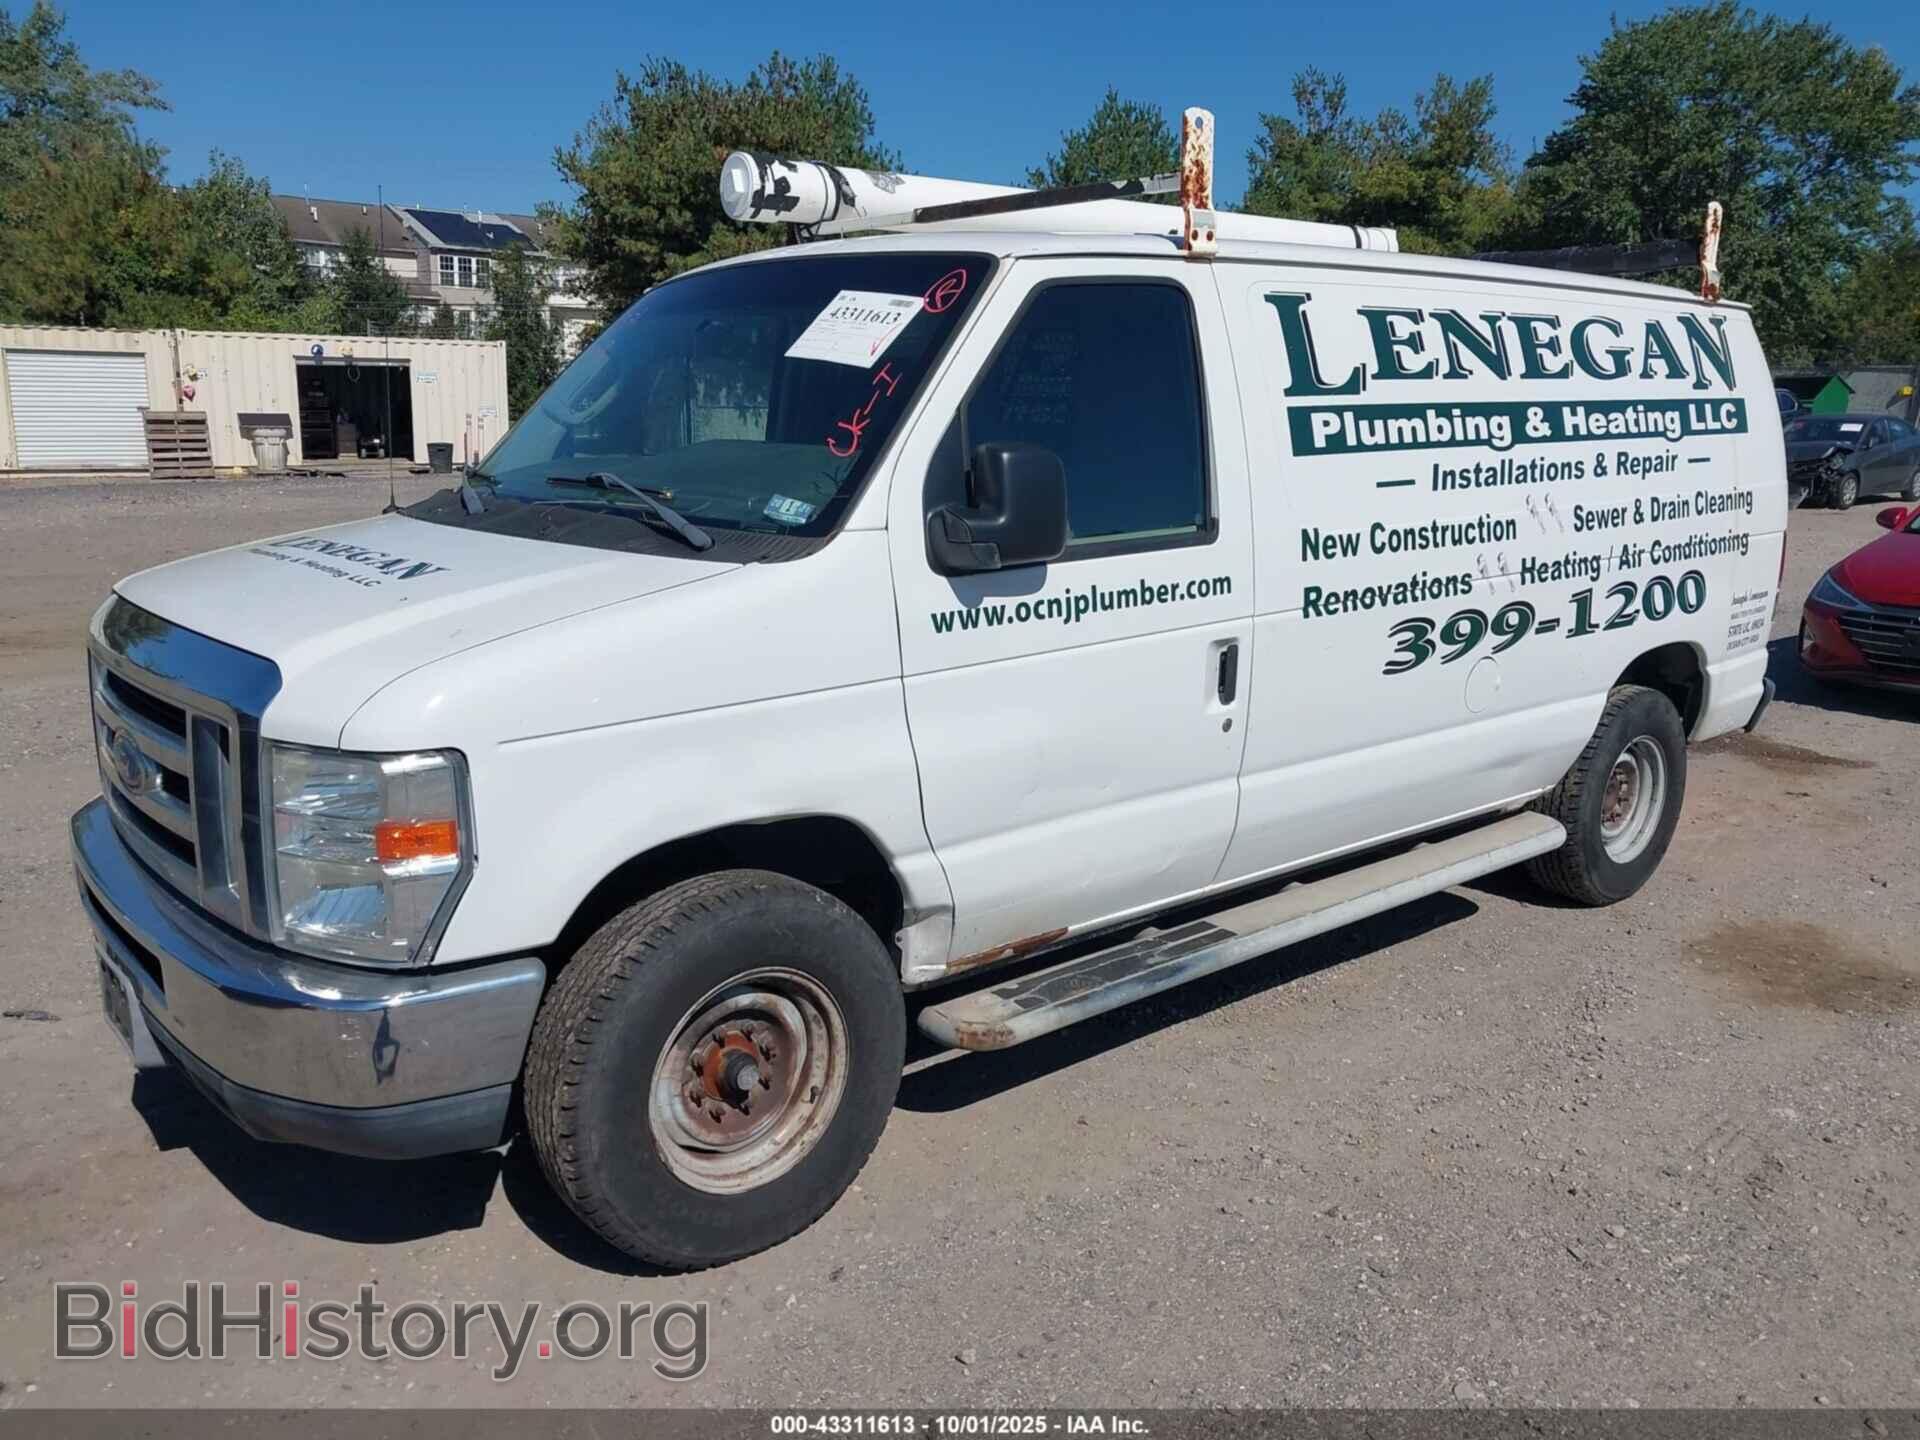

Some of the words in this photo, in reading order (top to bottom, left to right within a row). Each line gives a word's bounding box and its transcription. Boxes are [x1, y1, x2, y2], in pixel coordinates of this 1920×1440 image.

[829, 305, 902, 325] 43311613
[1264, 291, 1737, 397] LENEGAN
[1310, 408, 1512, 448] Plumbing
[1525, 406, 1552, 438] &
[1562, 404, 1682, 440] Heating
[1688, 402, 1738, 431] LLC
[1432, 456, 1585, 492] Installations
[1592, 452, 1608, 478] &
[1616, 449, 1678, 480] Repair
[1573, 504, 1628, 532] Sewer
[1633, 498, 1645, 525] &
[1651, 494, 1690, 523] Drain
[1694, 487, 1753, 516] Cleaning
[267, 536, 451, 580] LENEGAN
[1301, 527, 1361, 563] New
[1369, 513, 1517, 555] Construction
[1520, 550, 1602, 586] Heating
[1618, 543, 1646, 571] Air
[1650, 529, 1750, 566] Conditioning
[348, 574, 382, 588] LLC
[930, 575, 1232, 634] www.ocnjplumber.com
[1301, 571, 1473, 620] Renovations
[1382, 569, 1707, 676] 399-1200
